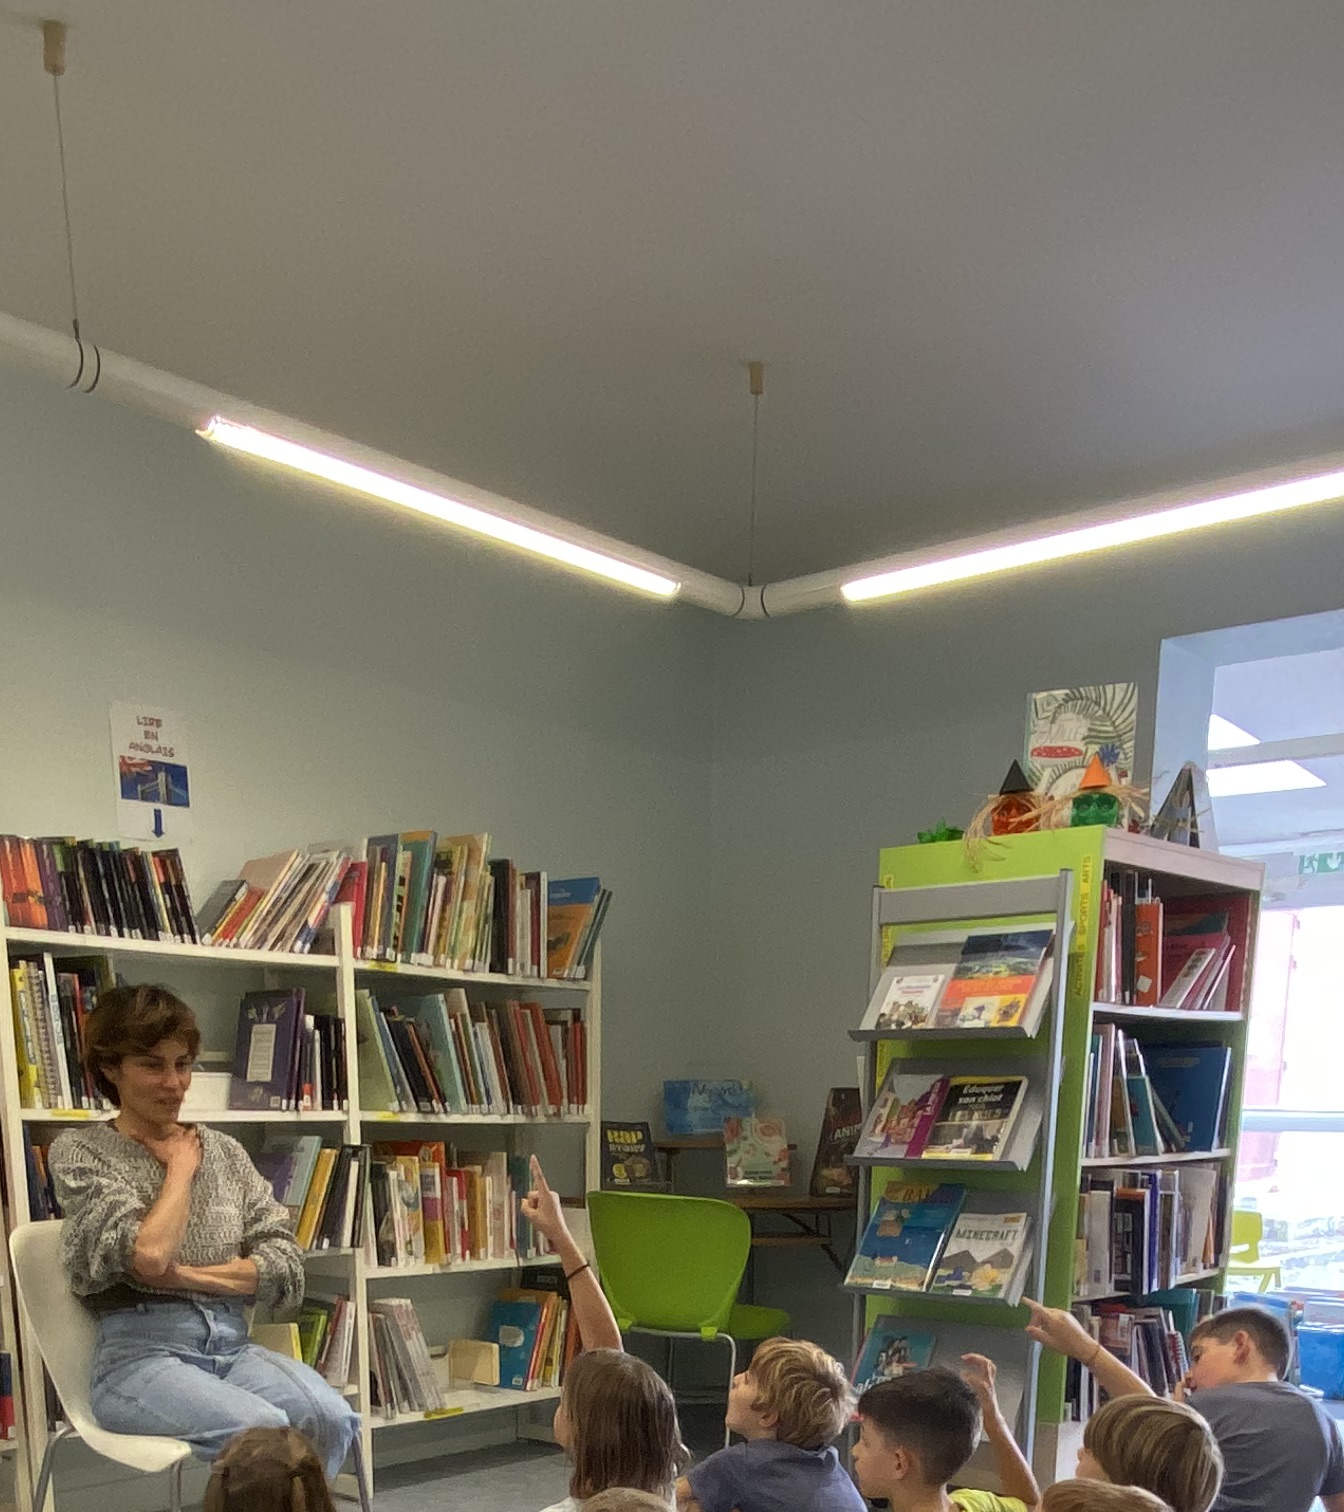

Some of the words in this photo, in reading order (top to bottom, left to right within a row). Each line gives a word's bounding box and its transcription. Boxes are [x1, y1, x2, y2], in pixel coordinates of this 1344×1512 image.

[144, 730, 158, 741] EN
[129, 742, 175, 757] ANGLAIS
[956, 1229, 1018, 1242] MINECRAFT
